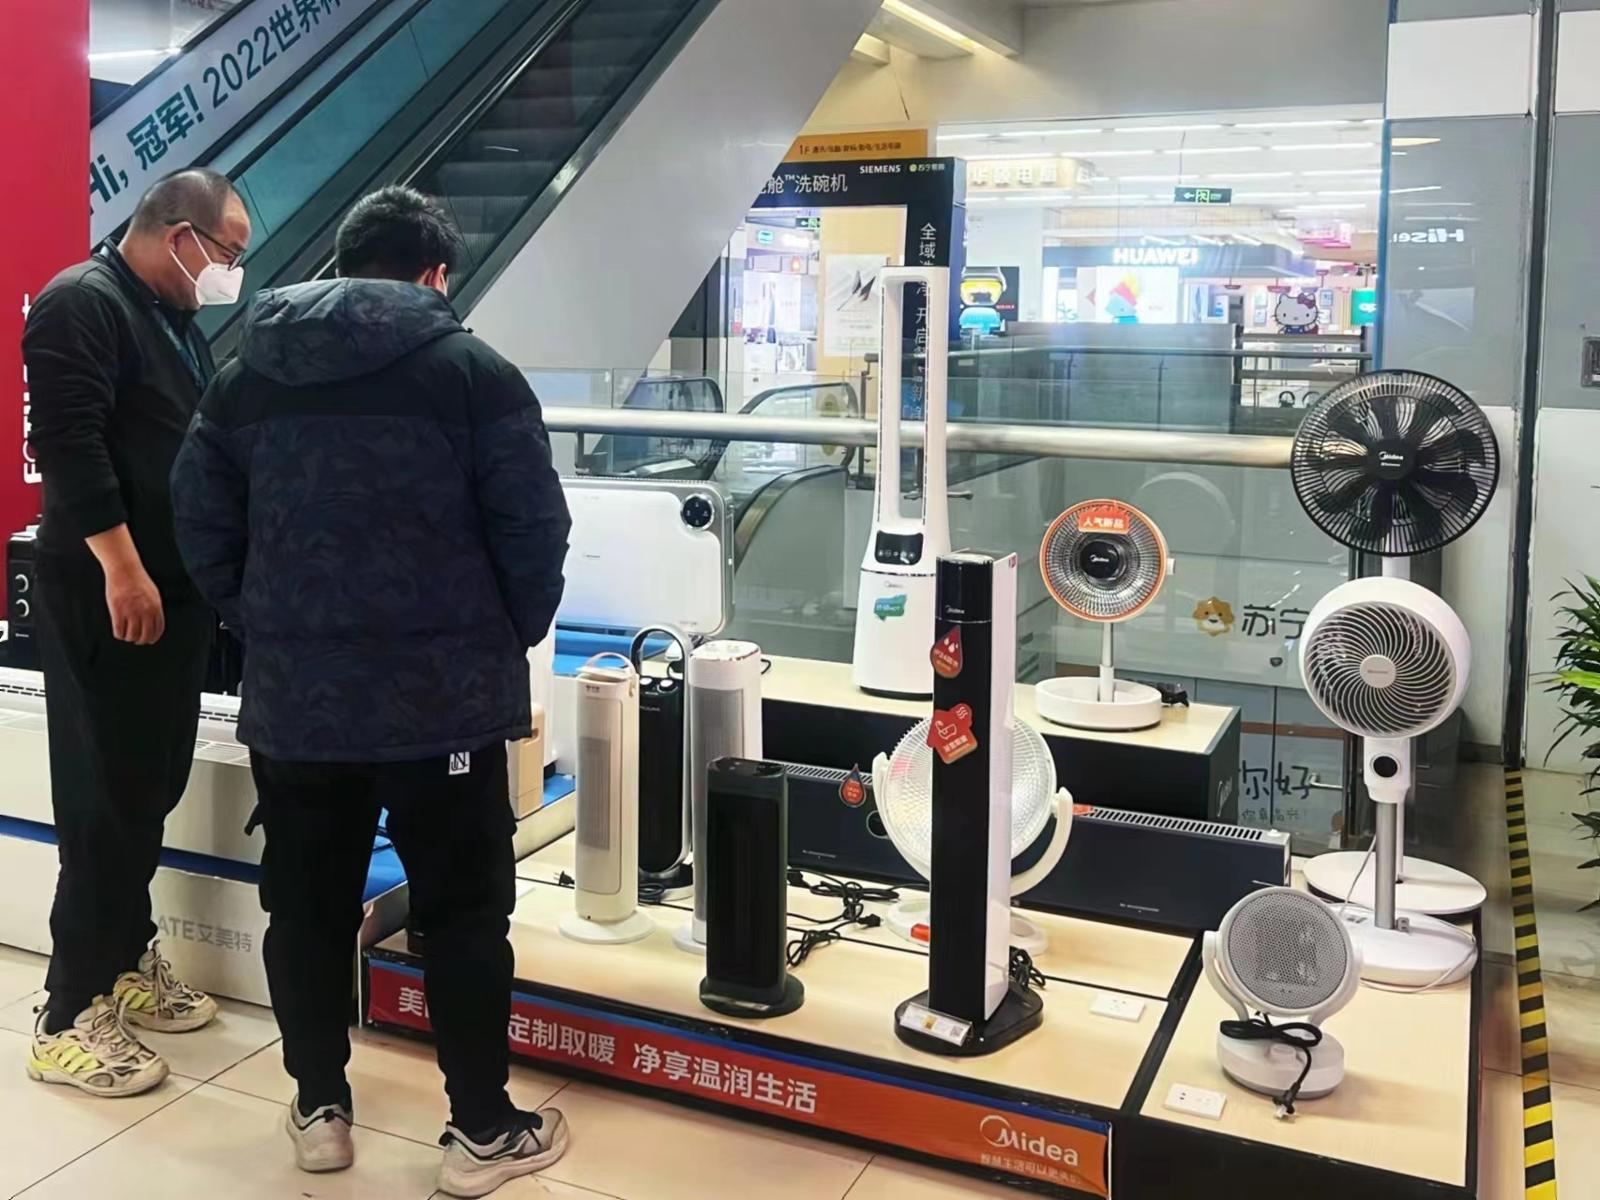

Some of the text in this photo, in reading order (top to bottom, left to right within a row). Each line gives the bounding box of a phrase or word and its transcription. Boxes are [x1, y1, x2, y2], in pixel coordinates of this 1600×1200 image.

[859, 164, 900, 174] SIEMENS
[1113, 247, 1199, 265] HUAWEI
[1241, 603, 1310, 640] 苏宁
[507, 1013, 615, 1065] 定制取暖
[632, 1042, 817, 1114] 净享温润生活
[980, 1114, 1079, 1167] Midea
